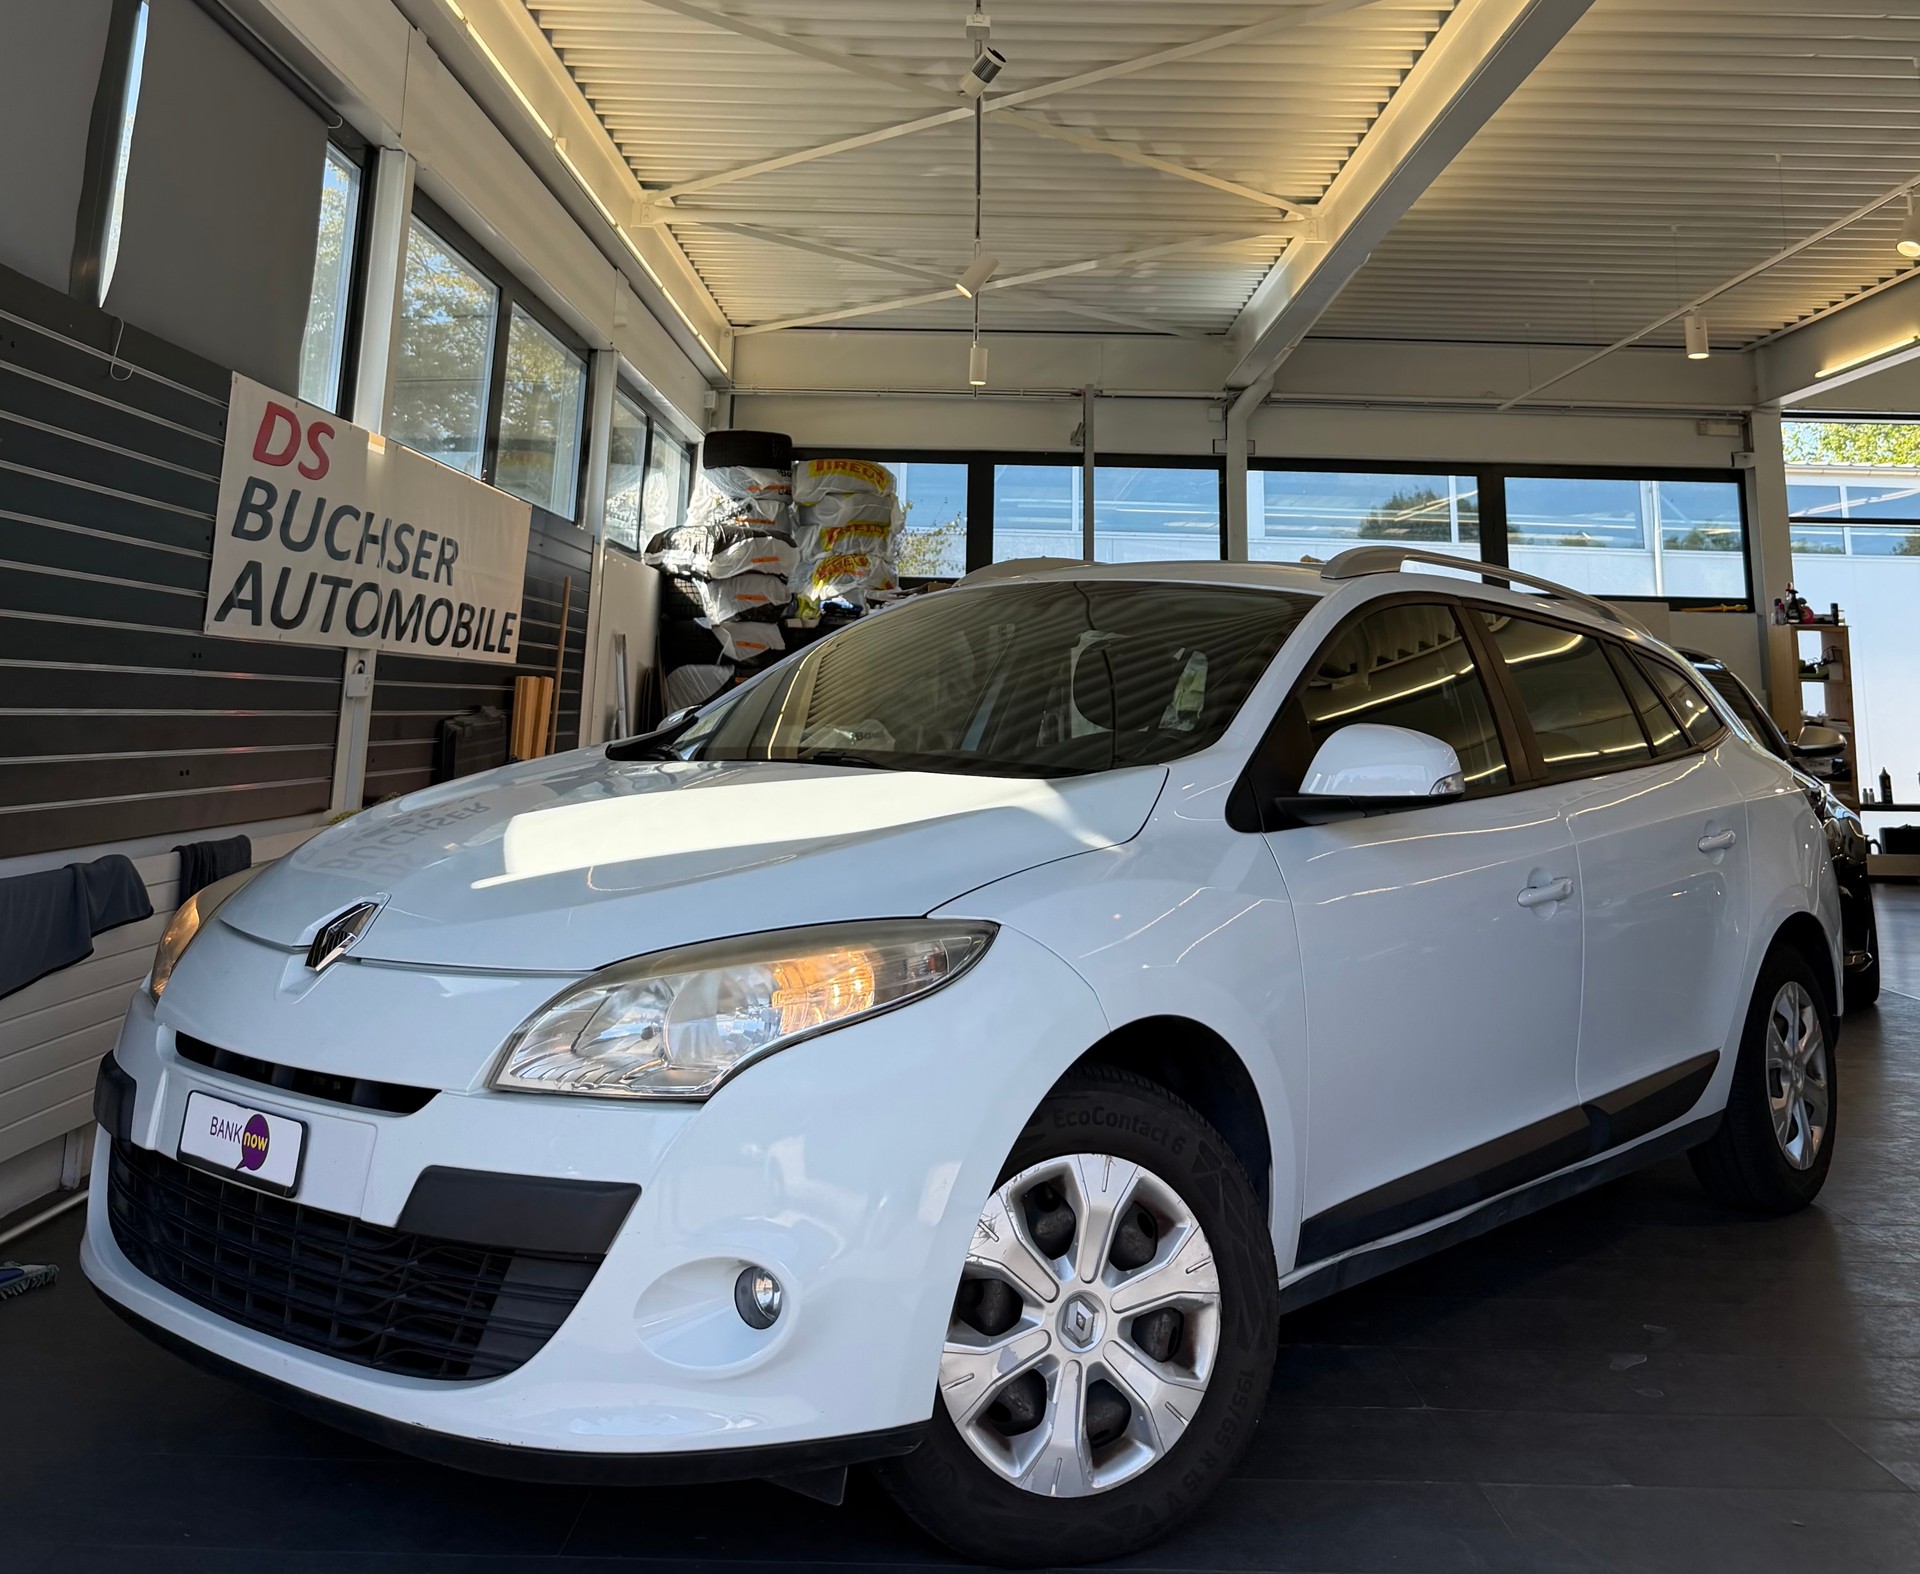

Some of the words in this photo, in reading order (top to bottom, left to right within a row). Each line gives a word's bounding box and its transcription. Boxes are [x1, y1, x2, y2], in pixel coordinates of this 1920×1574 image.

[252, 401, 335, 480] DS
[231, 476, 459, 587] BUCHSER
[214, 560, 518, 654] AUTOMOBILE
[209, 1116, 243, 1144] BANK
[243, 1132, 268, 1151] now
[1051, 1106, 1170, 1146] EcoContact
[1171, 1136, 1187, 1155] 6
[1214, 1369, 1256, 1448] 195/65
